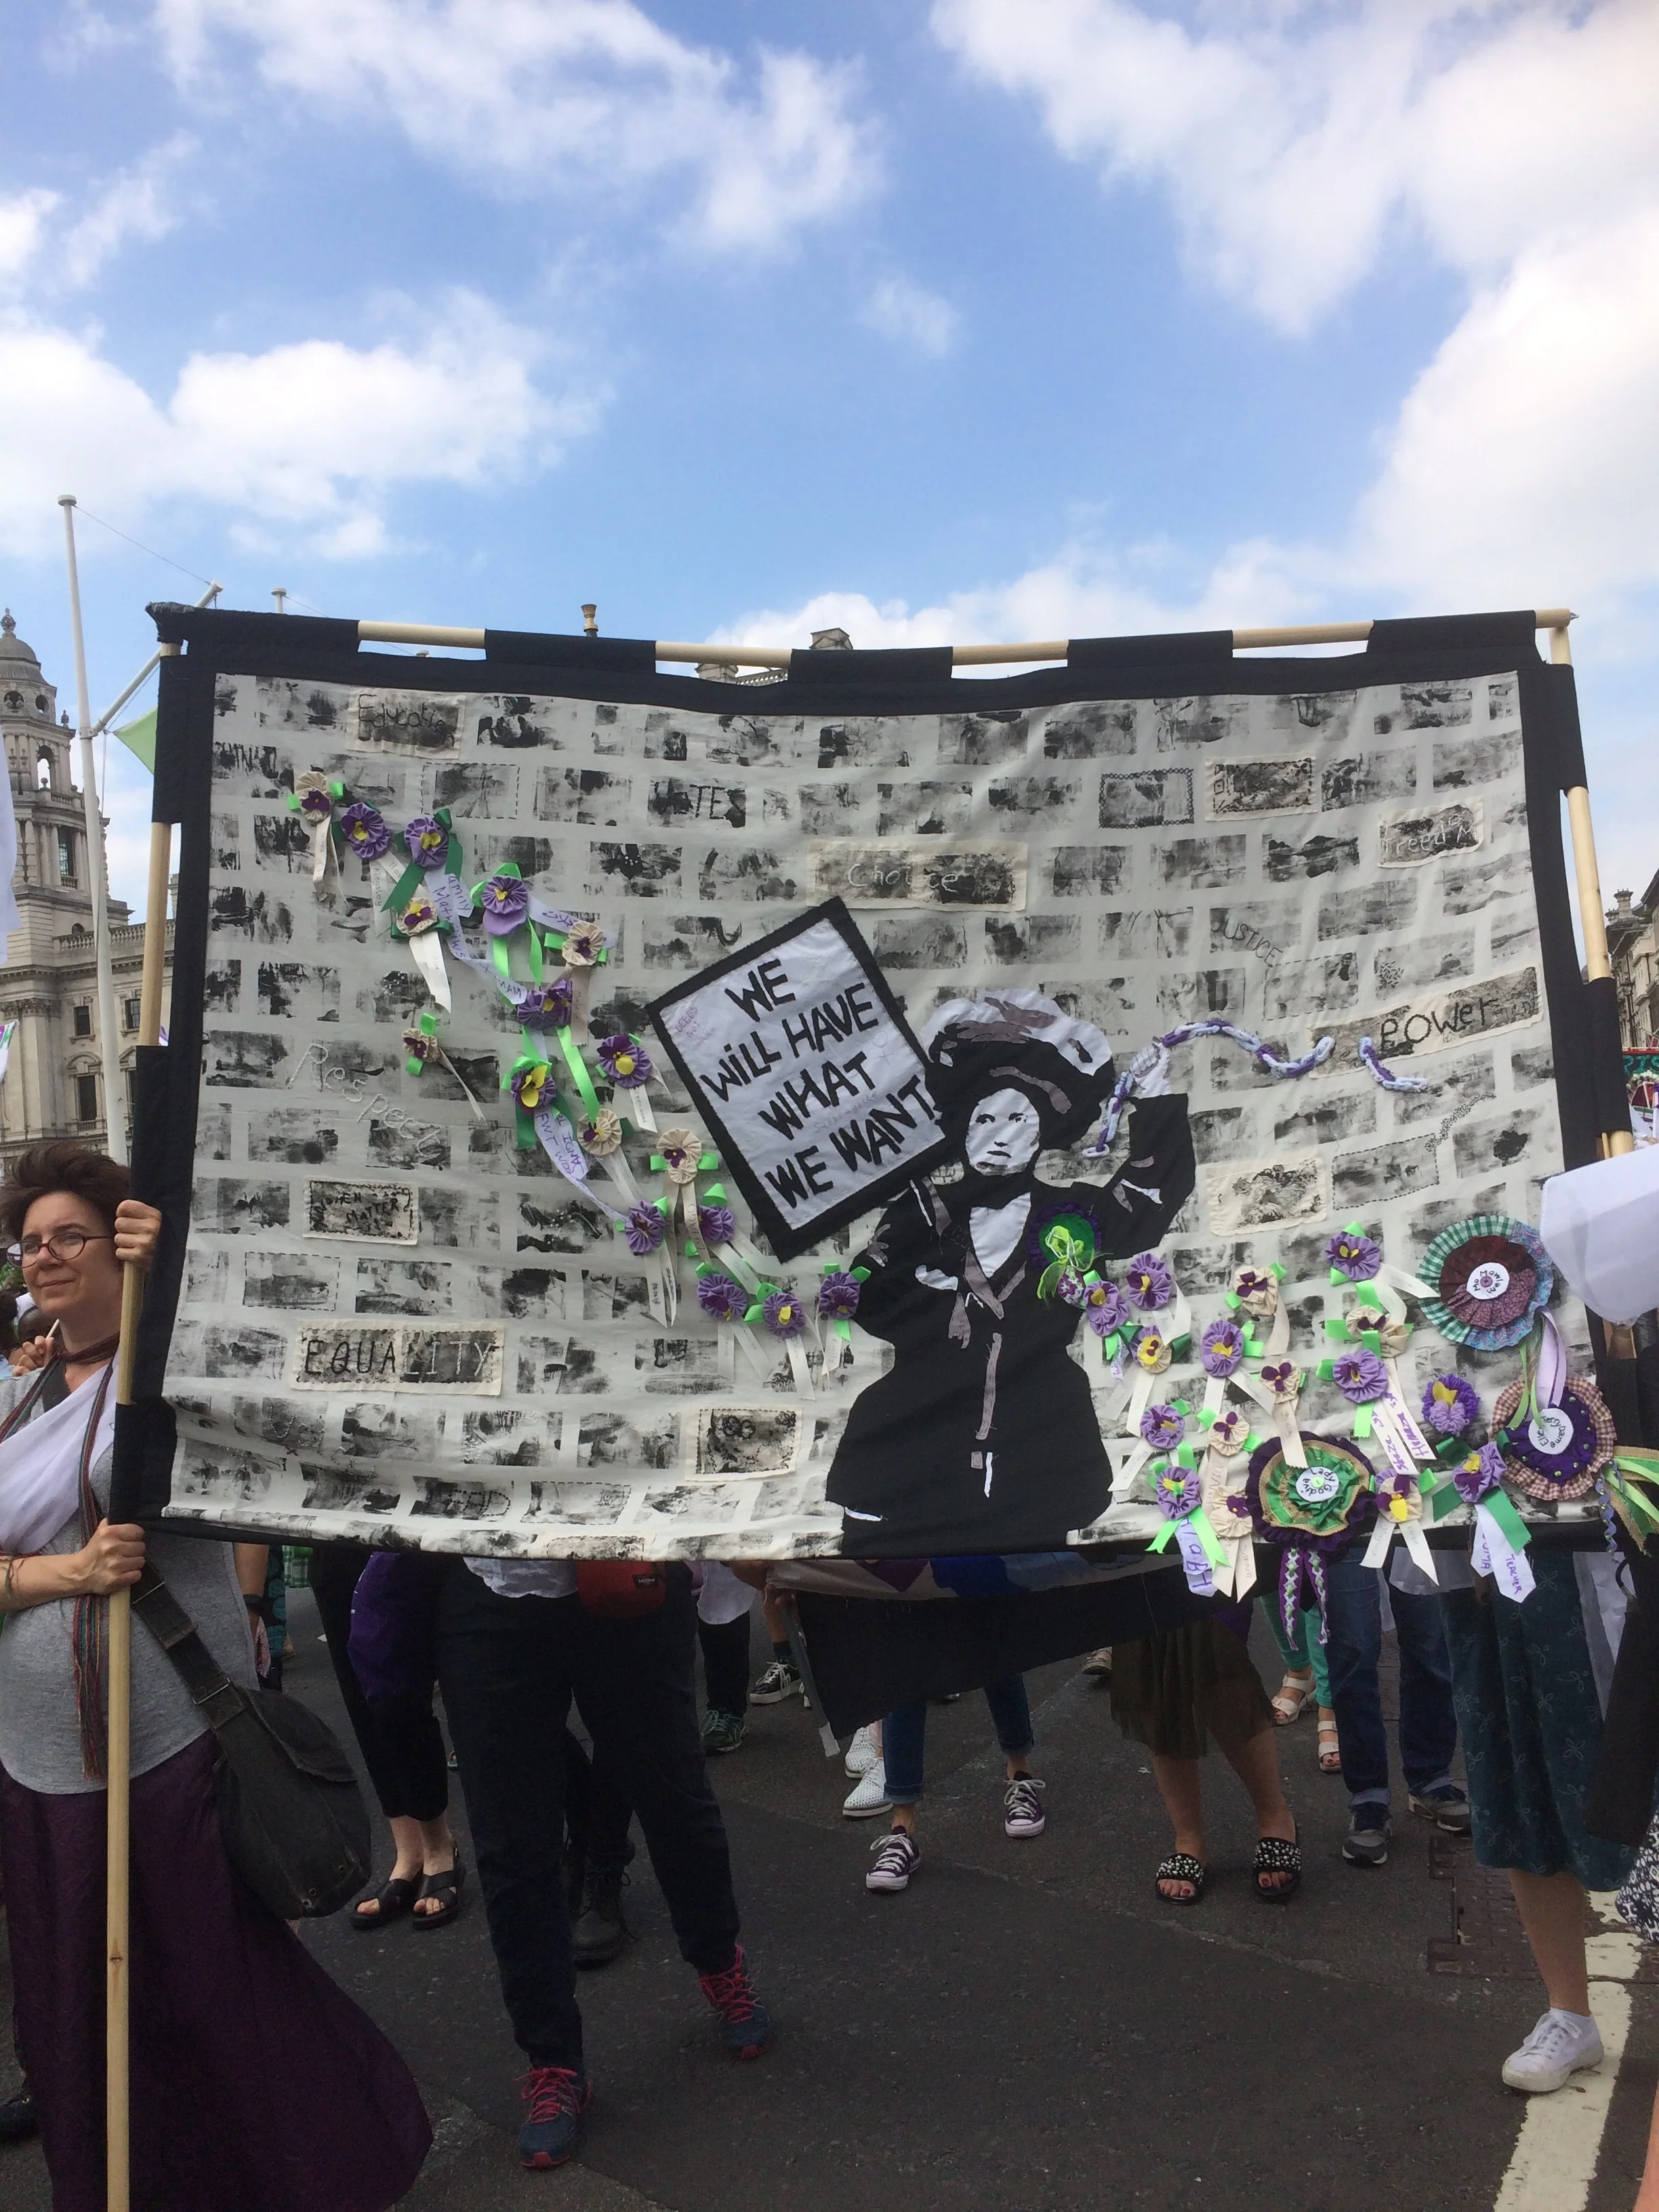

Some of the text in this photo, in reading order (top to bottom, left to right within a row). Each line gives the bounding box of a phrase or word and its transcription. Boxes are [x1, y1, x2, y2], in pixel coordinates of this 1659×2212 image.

[373, 867, 383, 907] Kingsley
[724, 958, 796, 1022] WE
[781, 982, 879, 1059] HAVE
[758, 1051, 876, 1140] WHAT
[764, 1075, 938, 1209] WE WANT
[304, 1339, 492, 1376] EQUALITY
[1311, 1467, 1336, 1483] Lady
[1504, 1553, 1523, 1595] TEACHER
